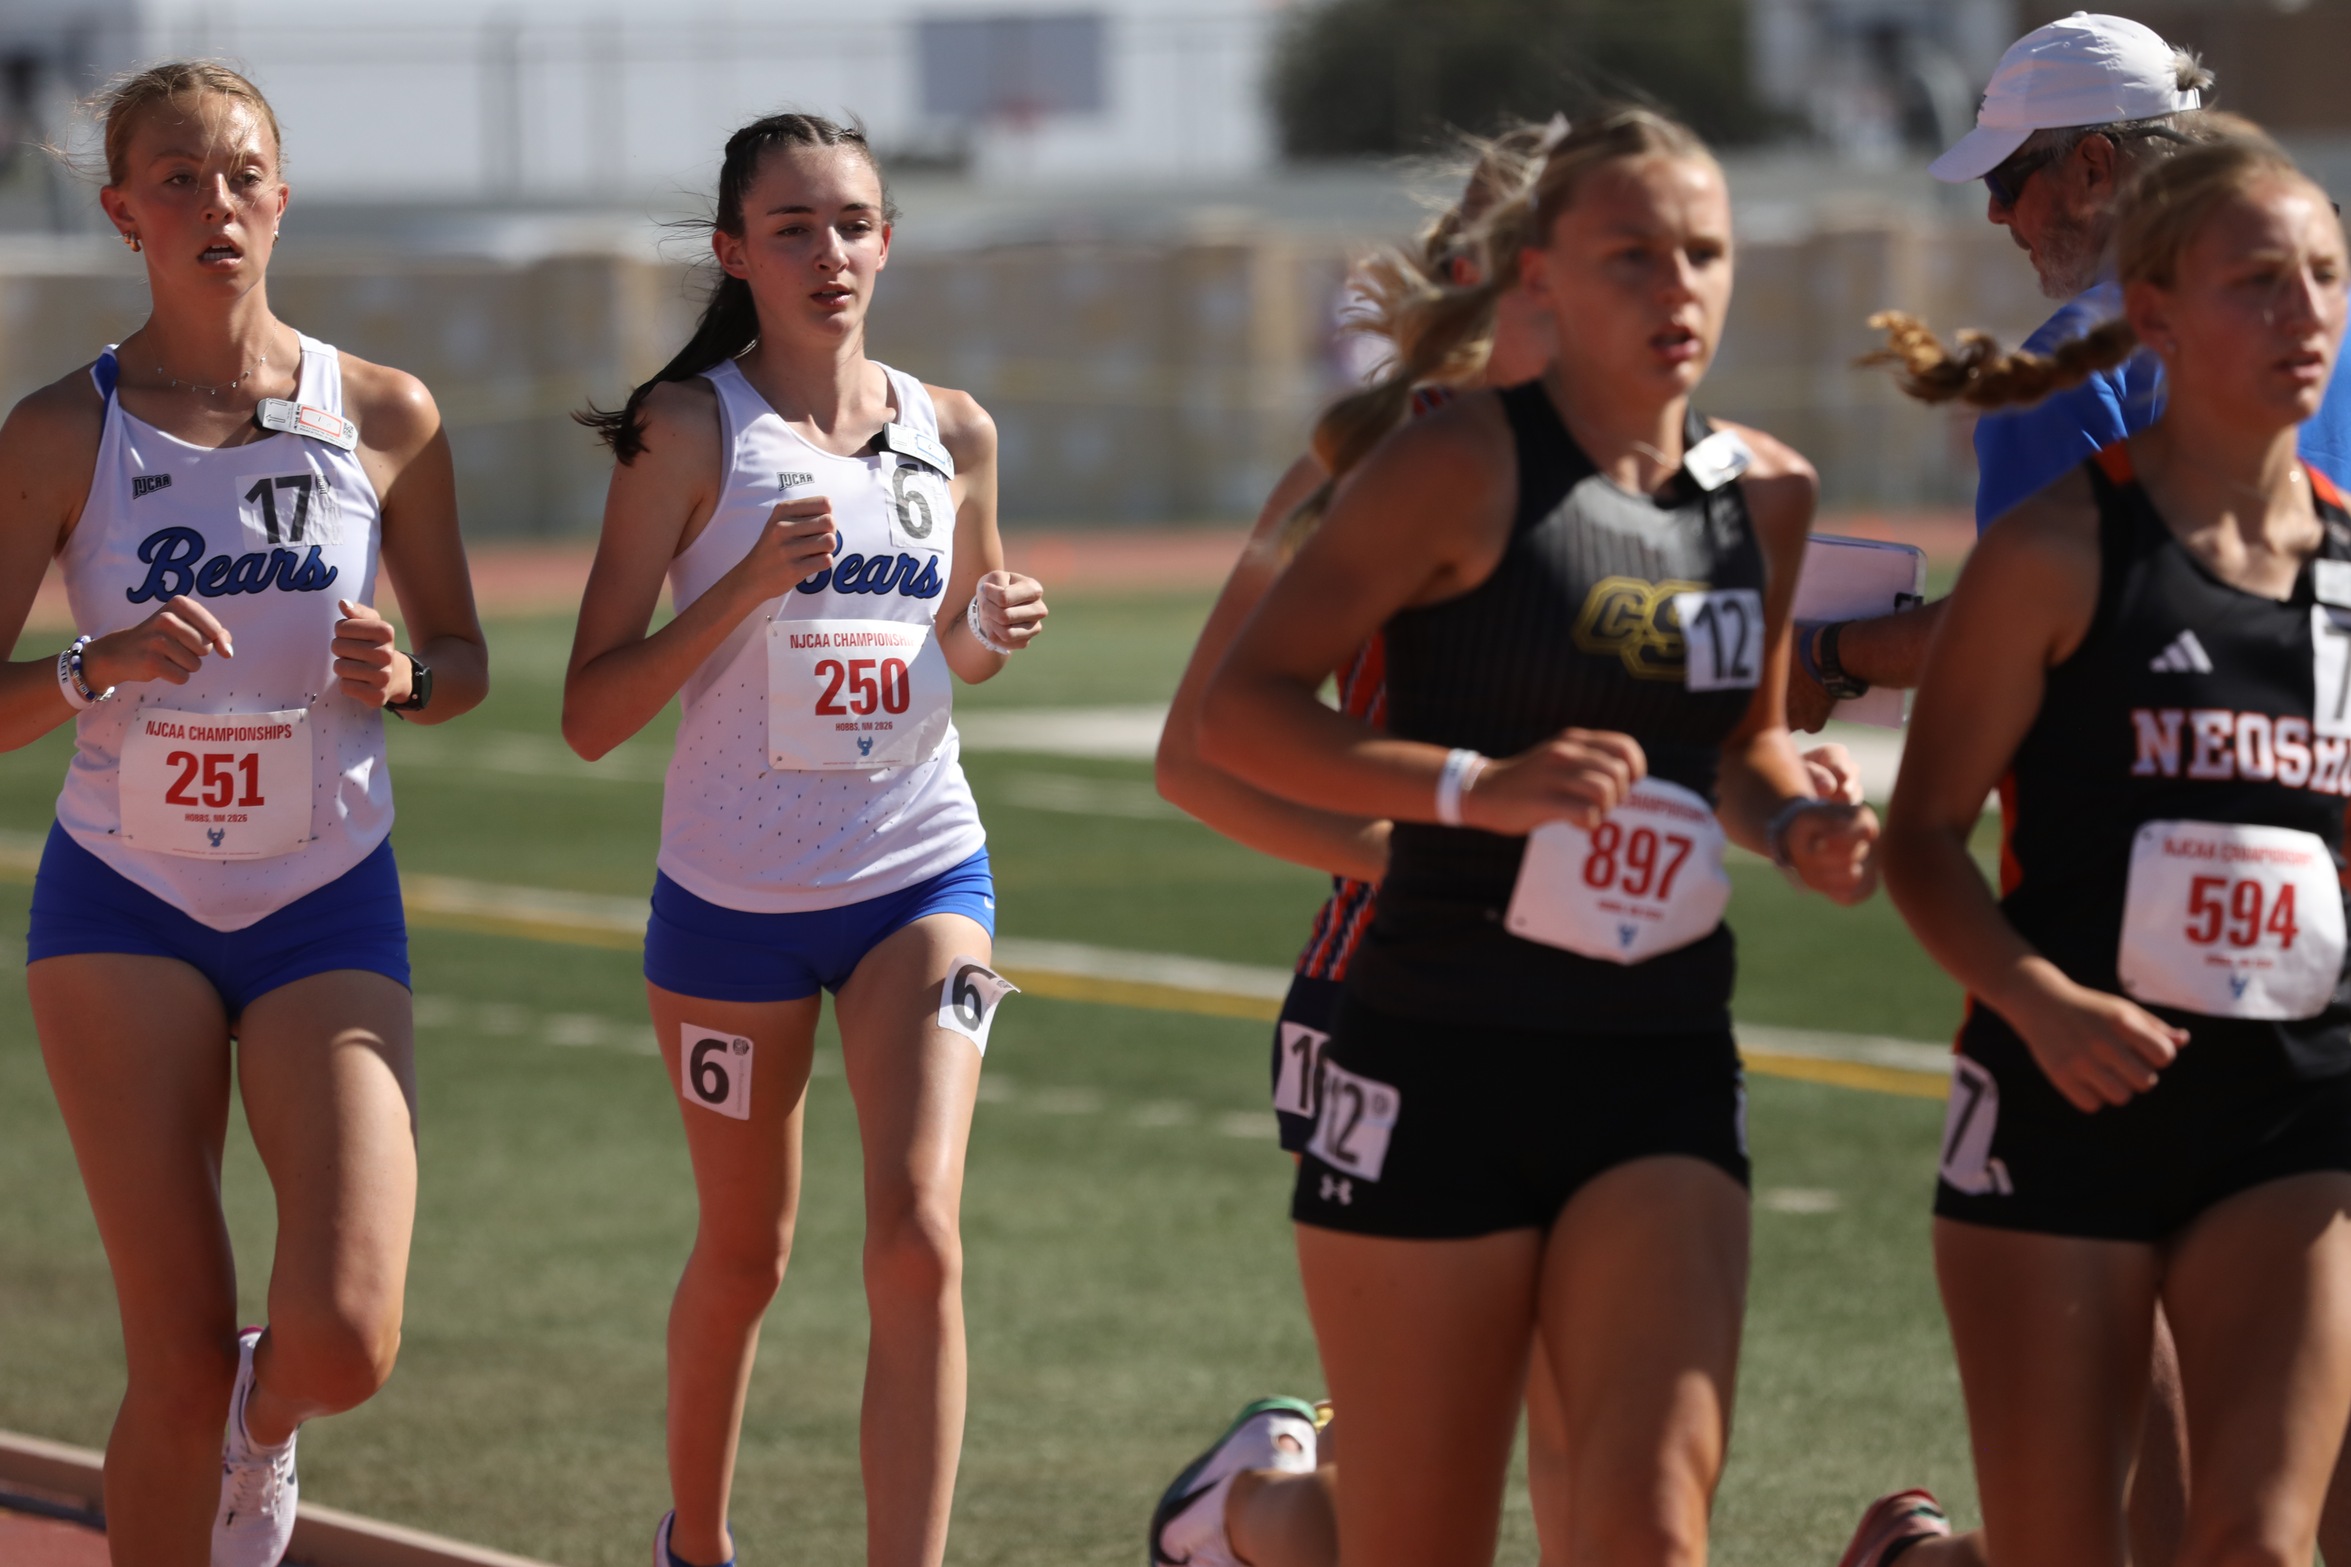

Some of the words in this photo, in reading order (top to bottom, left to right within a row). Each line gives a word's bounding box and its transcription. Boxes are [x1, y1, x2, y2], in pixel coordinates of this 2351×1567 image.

[132, 474, 172, 500] NJCAA
[245, 474, 312, 545] 17
[778, 472, 815, 491] NJCAA
[892, 464, 933, 540] 6
[126, 526, 338, 604] Bears
[790, 633, 830, 648] NJCAA
[1692, 600, 1753, 680] 12
[814, 658, 910, 716] 250
[145, 720, 185, 740] NJCAA
[189, 723, 292, 742] CHAMPIONSHIPS
[862, 722, 873, 731] NM
[165, 751, 265, 808] 251
[1583, 821, 1696, 902] 897
[2185, 875, 2299, 950] 594
[952, 964, 997, 1032] 6
[690, 1038, 729, 1105] 6
[1945, 1066, 1986, 1168] 7
